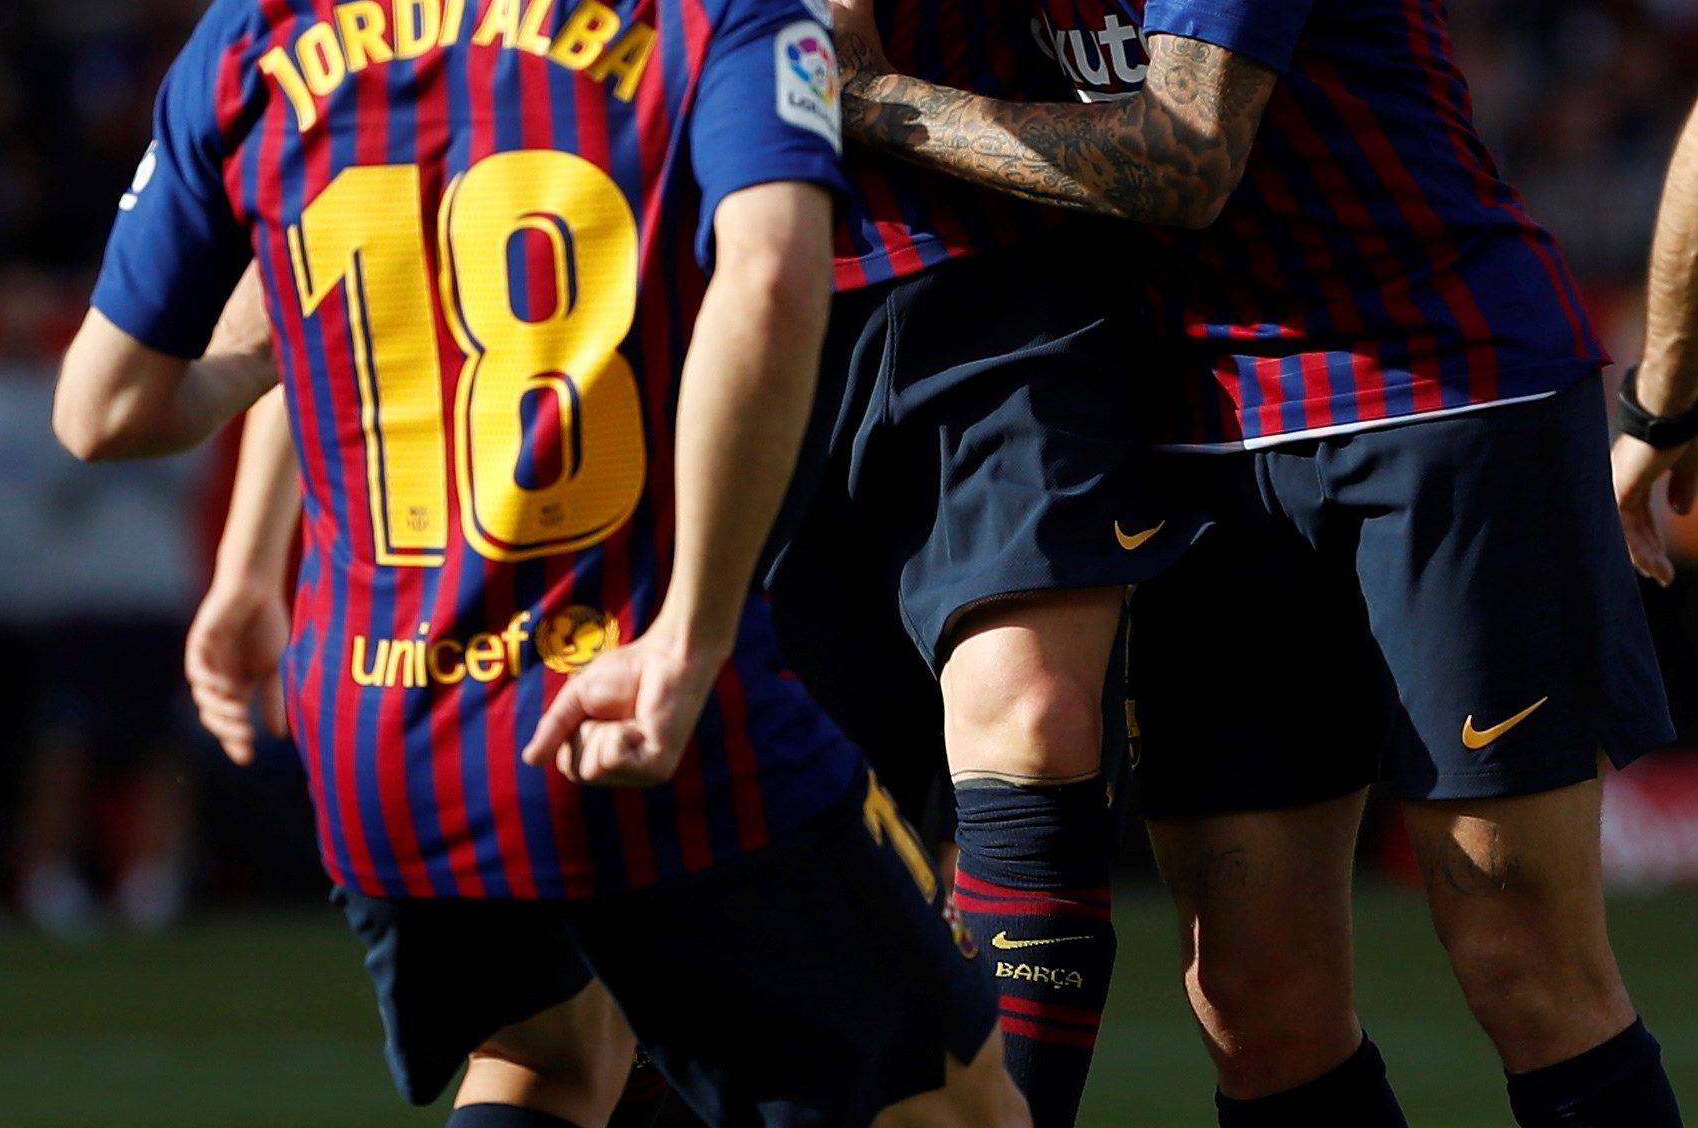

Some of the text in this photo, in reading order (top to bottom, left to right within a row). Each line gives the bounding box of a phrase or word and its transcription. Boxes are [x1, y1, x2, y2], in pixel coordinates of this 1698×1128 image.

[287, 149, 648, 567] 18
[350, 610, 533, 689] unicef
[994, 961, 1084, 989] BARÇA
